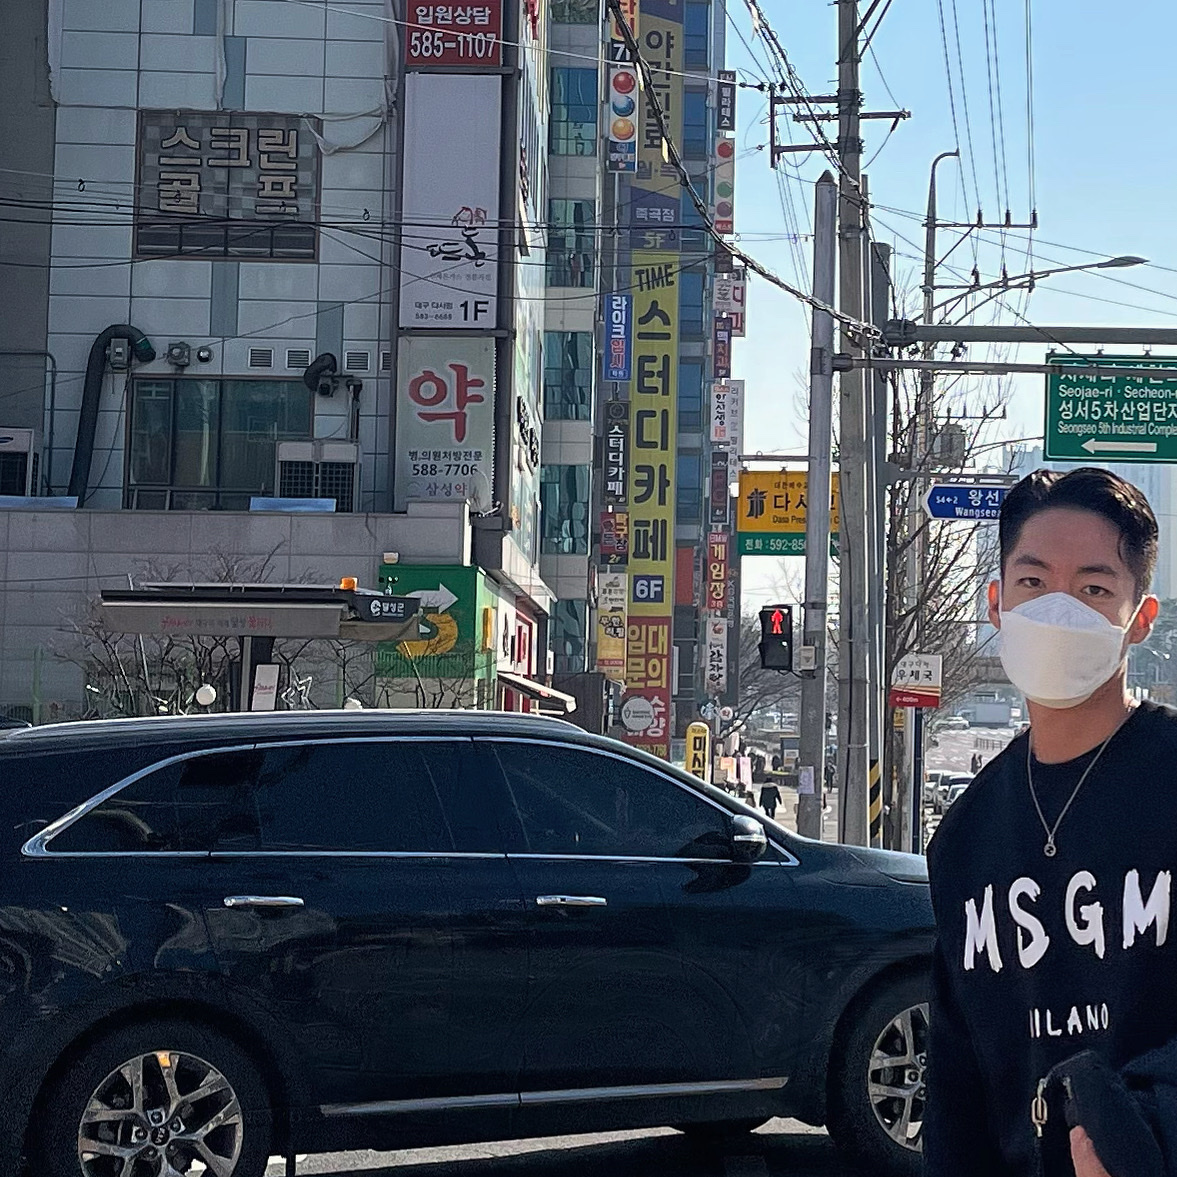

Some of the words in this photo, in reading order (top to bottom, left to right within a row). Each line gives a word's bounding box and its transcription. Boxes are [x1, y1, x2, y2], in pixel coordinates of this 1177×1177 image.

[415, 5, 491, 25] 입원상담
[410, 31, 497, 58] 585-1107
[159, 126, 298, 170] 스크린
[158, 172, 299, 214] 골프
[635, 264, 675, 292] TIME
[459, 300, 489, 321] 1F
[408, 363, 485, 443] 약
[1058, 384, 1113, 400] Seojae-ri
[633, 299, 672, 562] 스터디카페
[1057, 421, 1097, 437] Seongseo
[412, 463, 478, 477] 588-7706
[607, 425, 625, 496] 스터디카페
[745, 538, 763, 551] 전화
[709, 544, 725, 600] 게임장
[635, 579, 663, 599] 6F
[628, 624, 668, 656] 임대
[626, 657, 667, 689] 문의
[897, 669, 933, 681] 우체국
[963, 868, 1172, 973] MSGM
